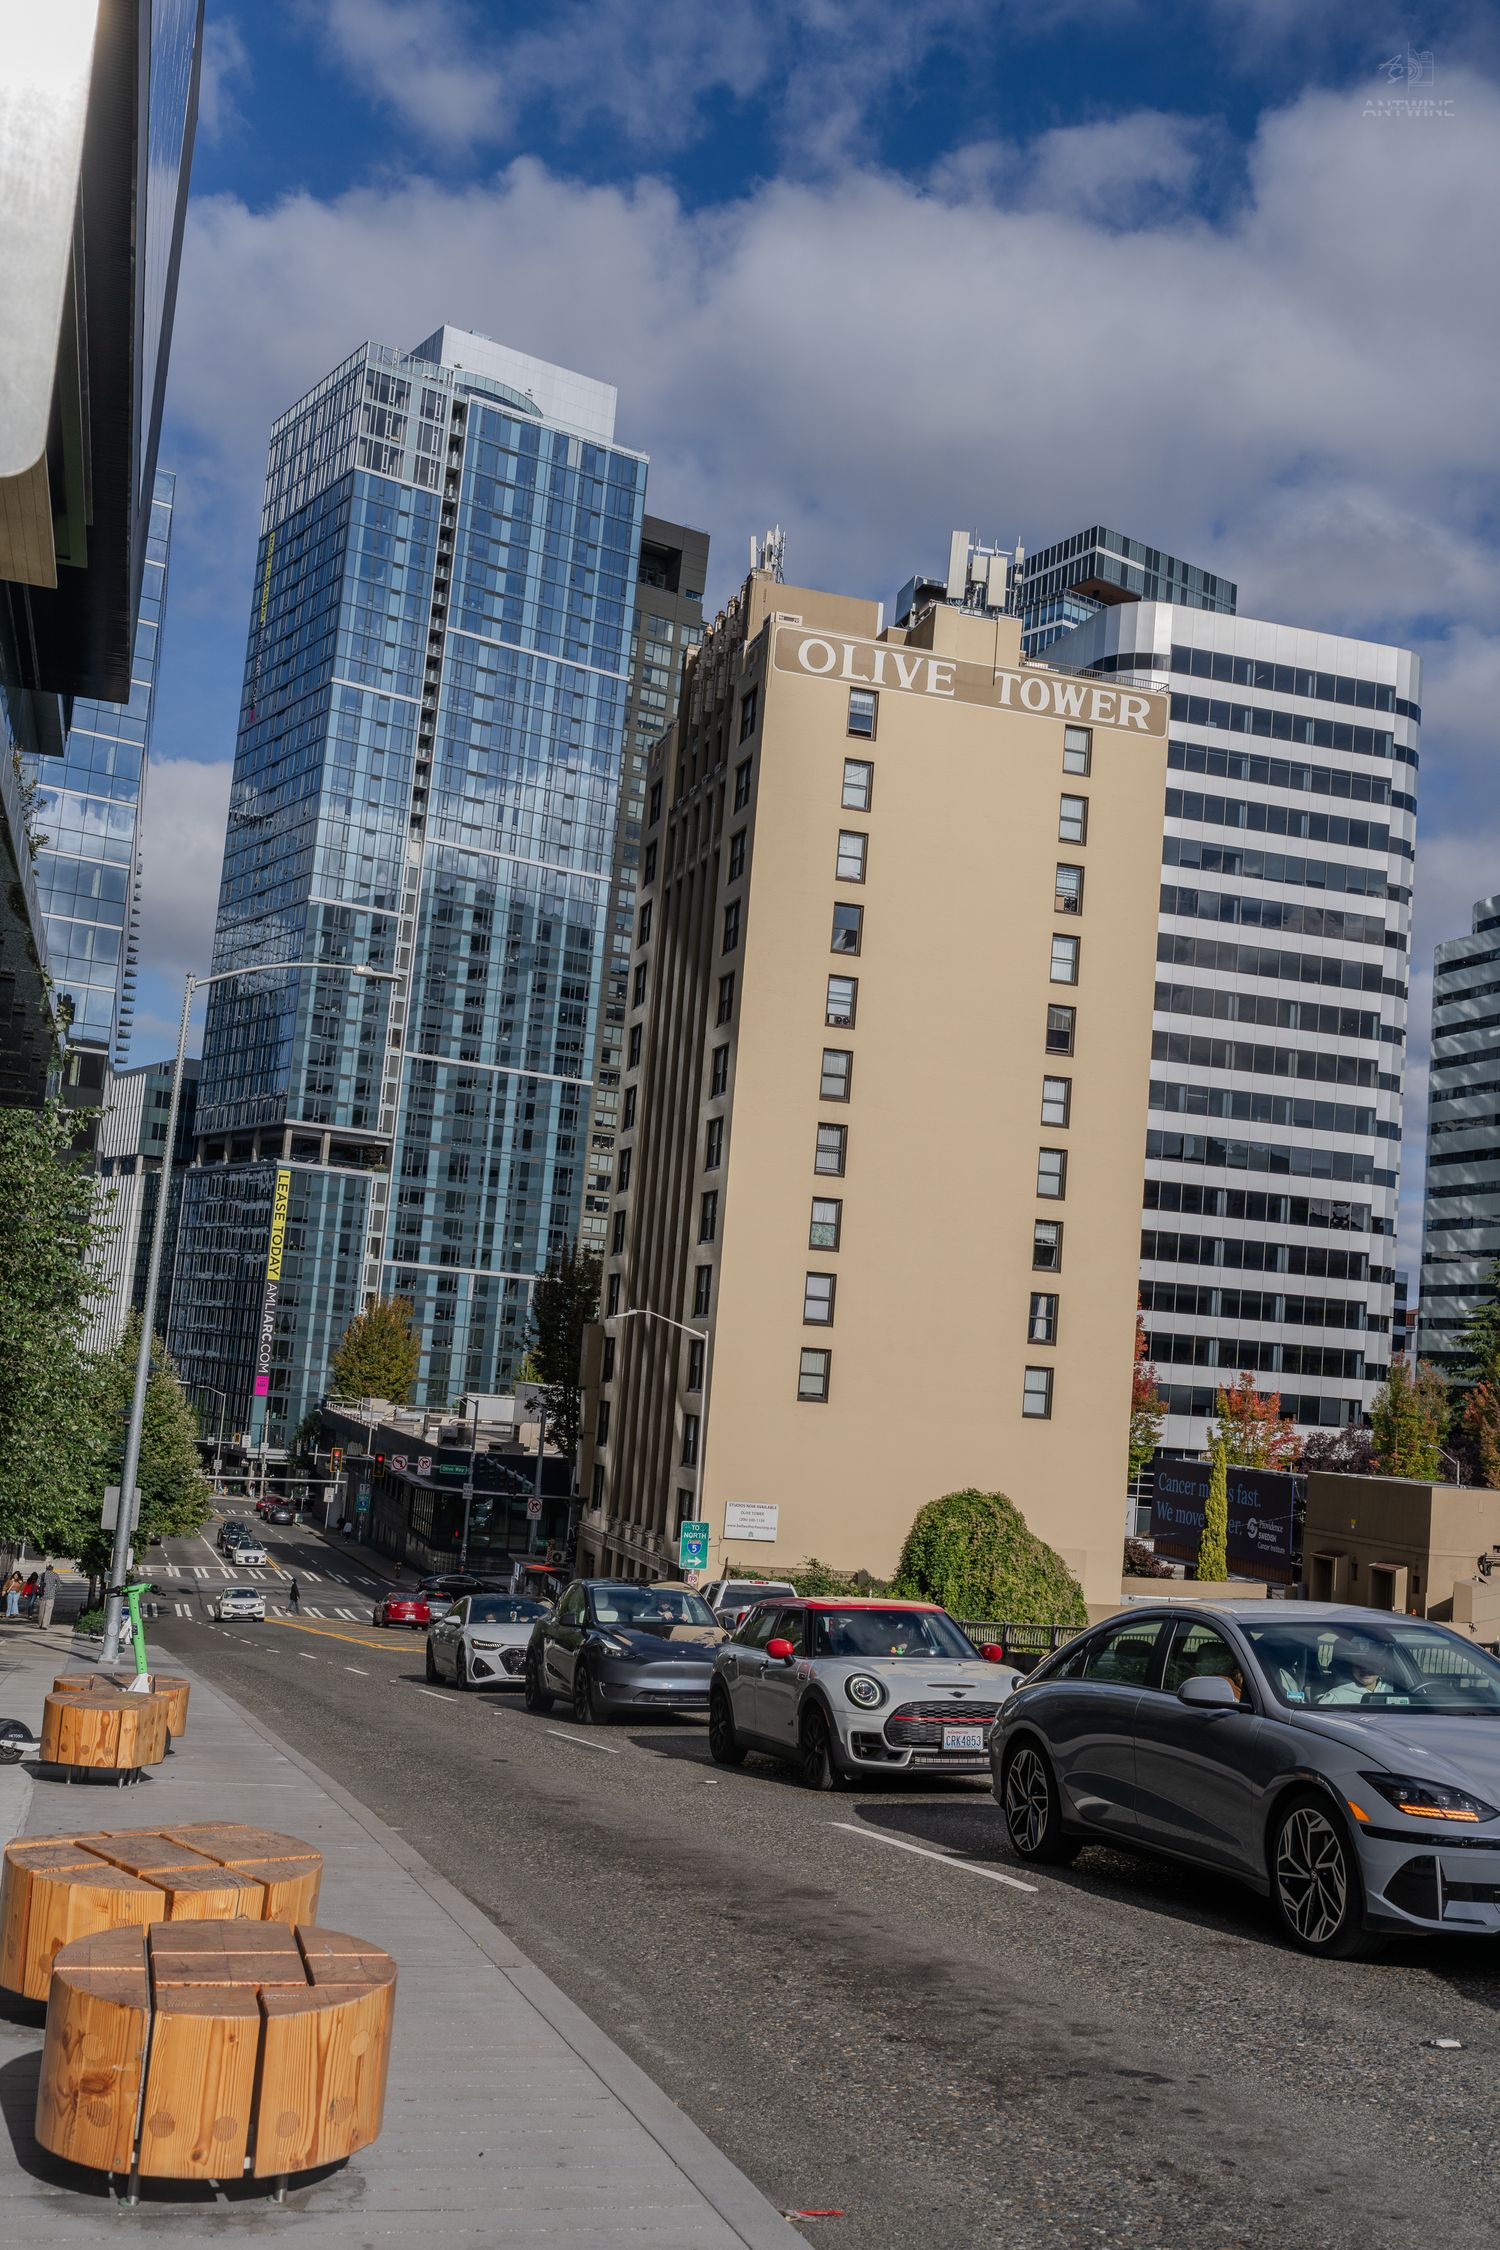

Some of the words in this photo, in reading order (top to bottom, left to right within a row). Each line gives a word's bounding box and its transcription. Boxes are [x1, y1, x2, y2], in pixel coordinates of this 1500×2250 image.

[798, 638, 956, 697] OLIVE
[994, 671, 1151, 730] TOWER
[275, 1175, 289, 1222] LEASE
[269, 1226, 283, 1276] TODAY
[259, 1282, 277, 1373] AMLIARC.COM
[1158, 1472, 1196, 1496] Cancer
[1237, 1483, 1262, 1508] fast.
[1157, 1500, 1173, 1521] We
[1175, 1507, 1205, 1528] move
[1259, 1519, 1284, 1533] Providence
[691, 1544, 698, 1553] 5
[1258, 1532, 1277, 1543] SWEDISH
[946, 1736, 981, 1746] CRK4853
